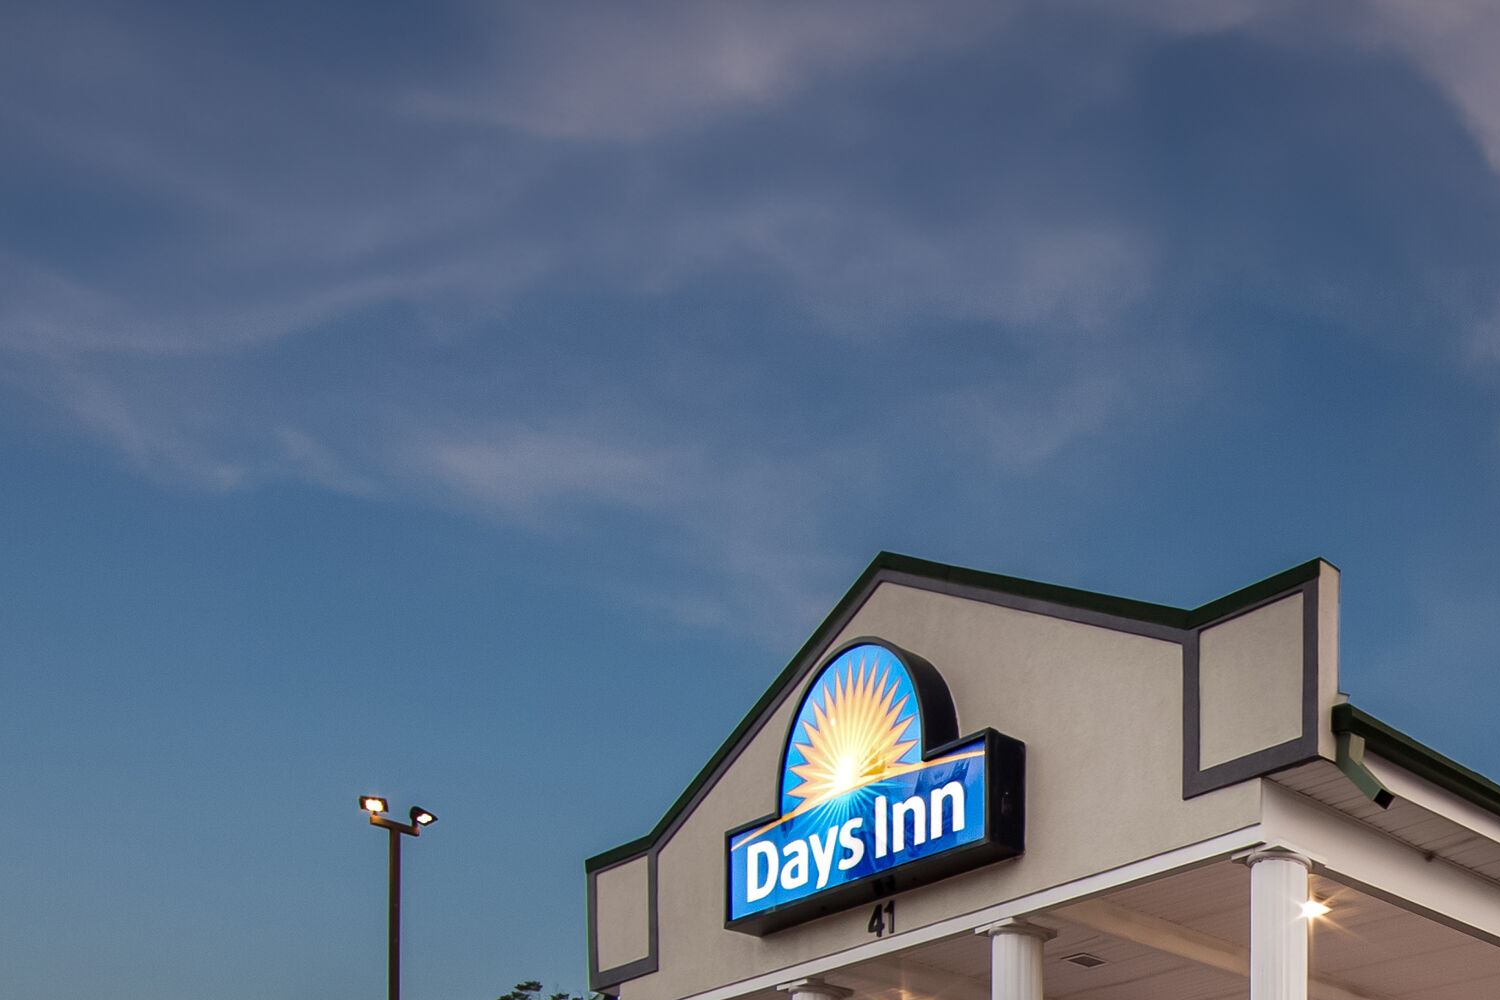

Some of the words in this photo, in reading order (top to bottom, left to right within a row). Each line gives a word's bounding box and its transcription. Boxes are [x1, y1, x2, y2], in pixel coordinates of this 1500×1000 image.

[747, 817, 864, 902] Days
[875, 781, 965, 859] Inn
[867, 900, 895, 937] 41
